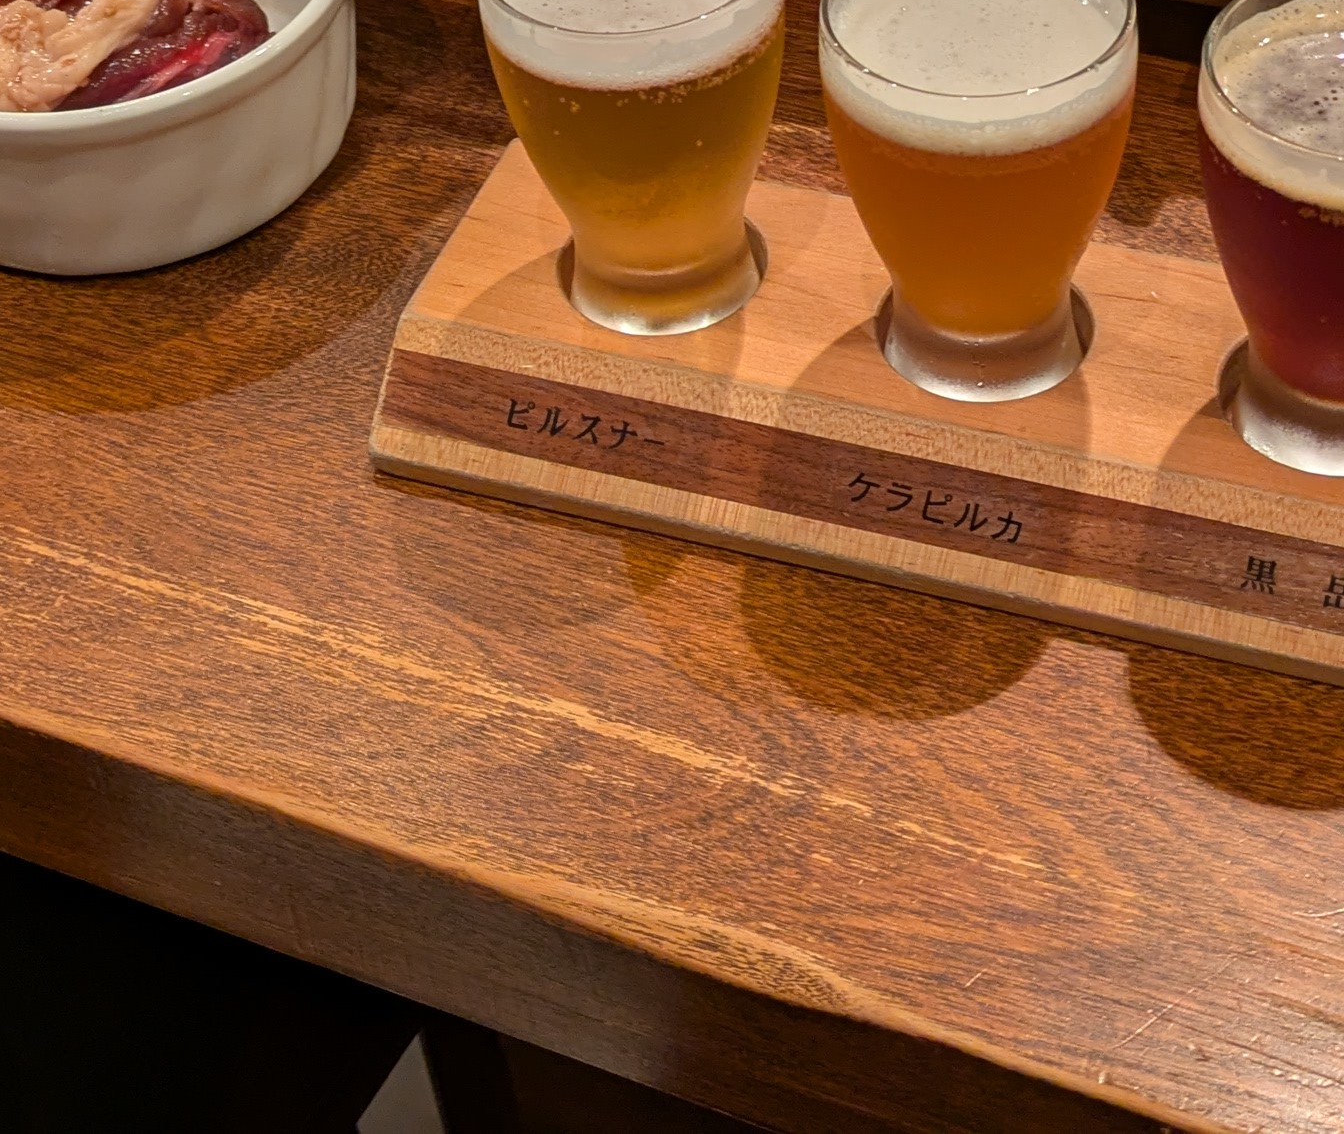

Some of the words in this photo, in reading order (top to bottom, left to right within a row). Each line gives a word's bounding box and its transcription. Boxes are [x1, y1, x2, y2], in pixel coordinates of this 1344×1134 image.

[506, 396, 666, 450] ピルスナー
